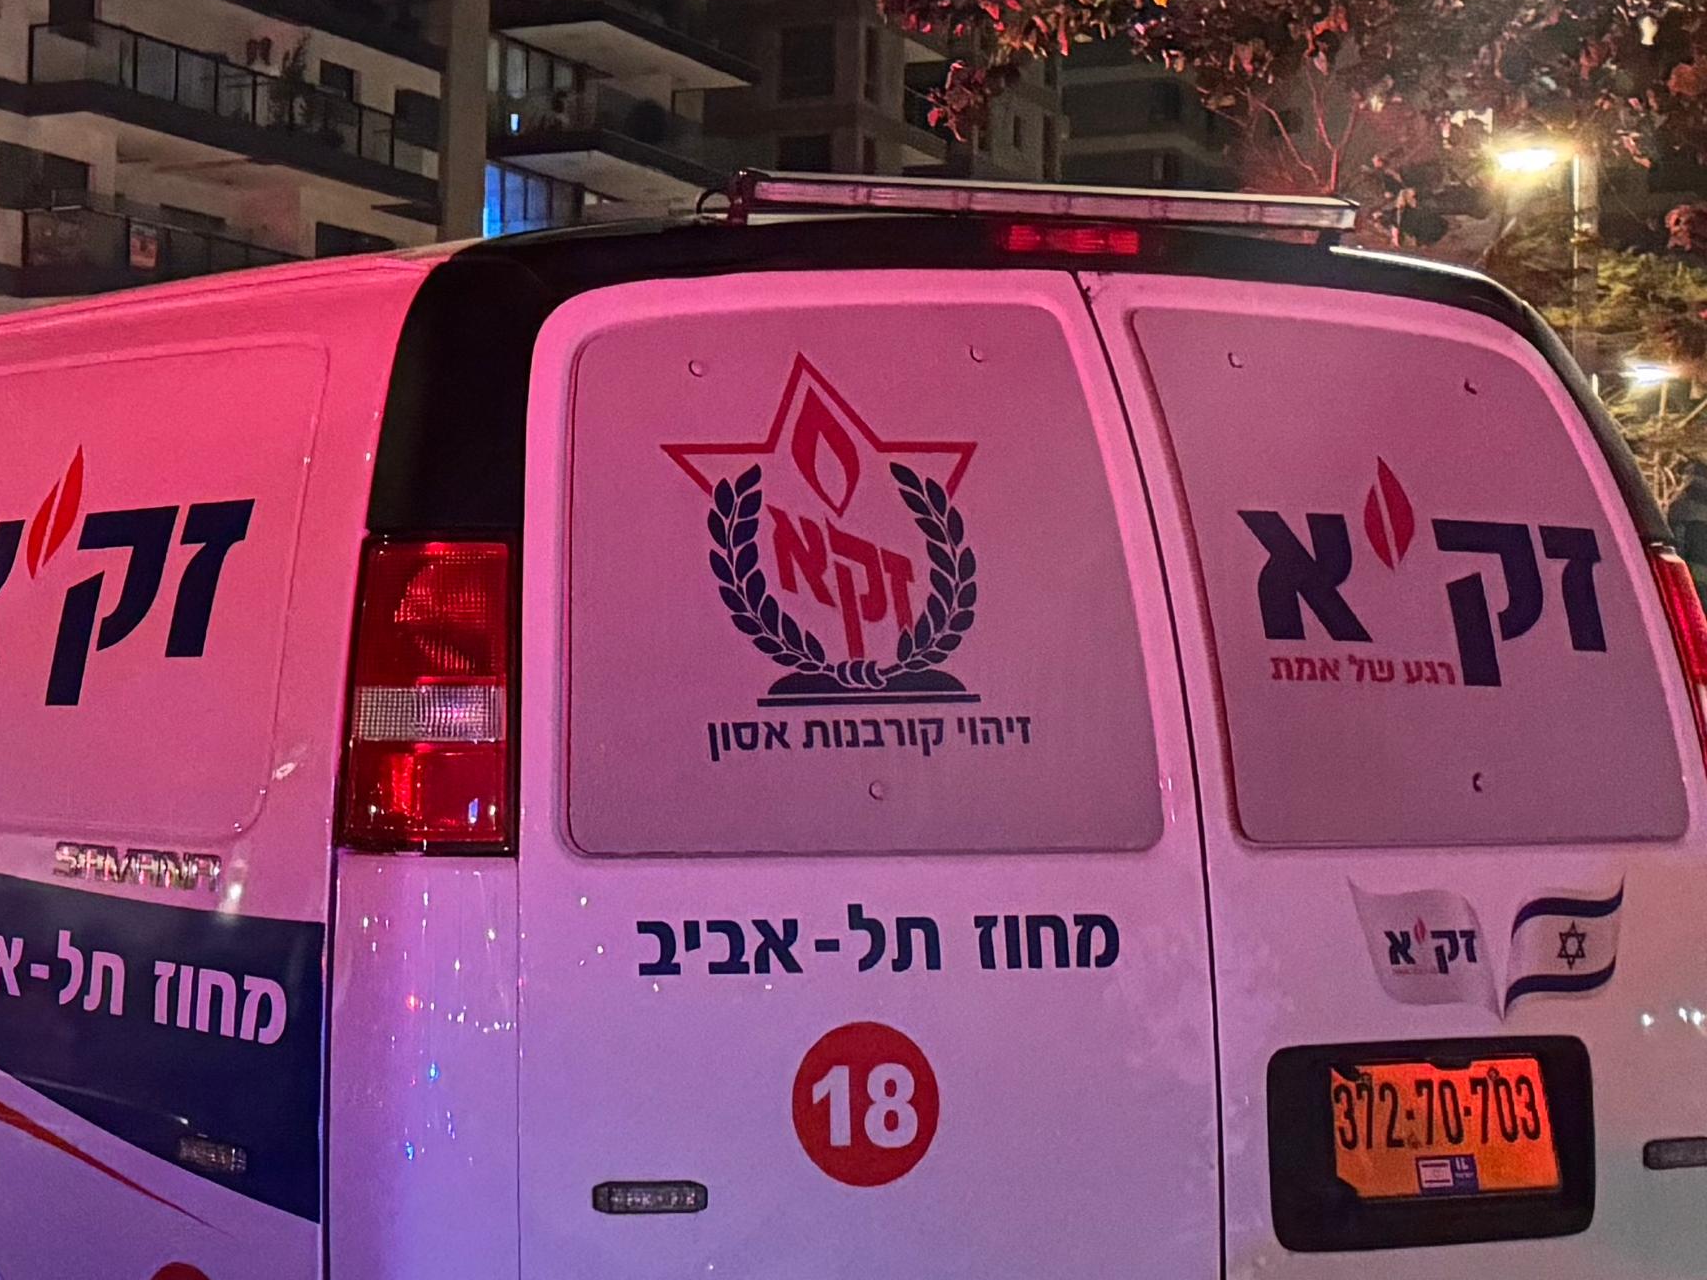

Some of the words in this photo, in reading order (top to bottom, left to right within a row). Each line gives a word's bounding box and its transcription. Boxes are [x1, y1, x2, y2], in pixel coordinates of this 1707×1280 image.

[1270, 657, 1340, 682] אמת
[1348, 654, 1395, 683] של
[1405, 660, 1455, 685] רגע
[708, 720, 790, 761] אסון
[803, 716, 943, 756] קורבנות
[958, 716, 1031, 746] זיהוי
[54, 841, 222, 892] SAVANA
[636, 904, 942, 976] תל-אביב
[974, 914, 1120, 970] מחוז
[154, 964, 286, 1045] מחוז
[811, 1062, 918, 1148] 18
